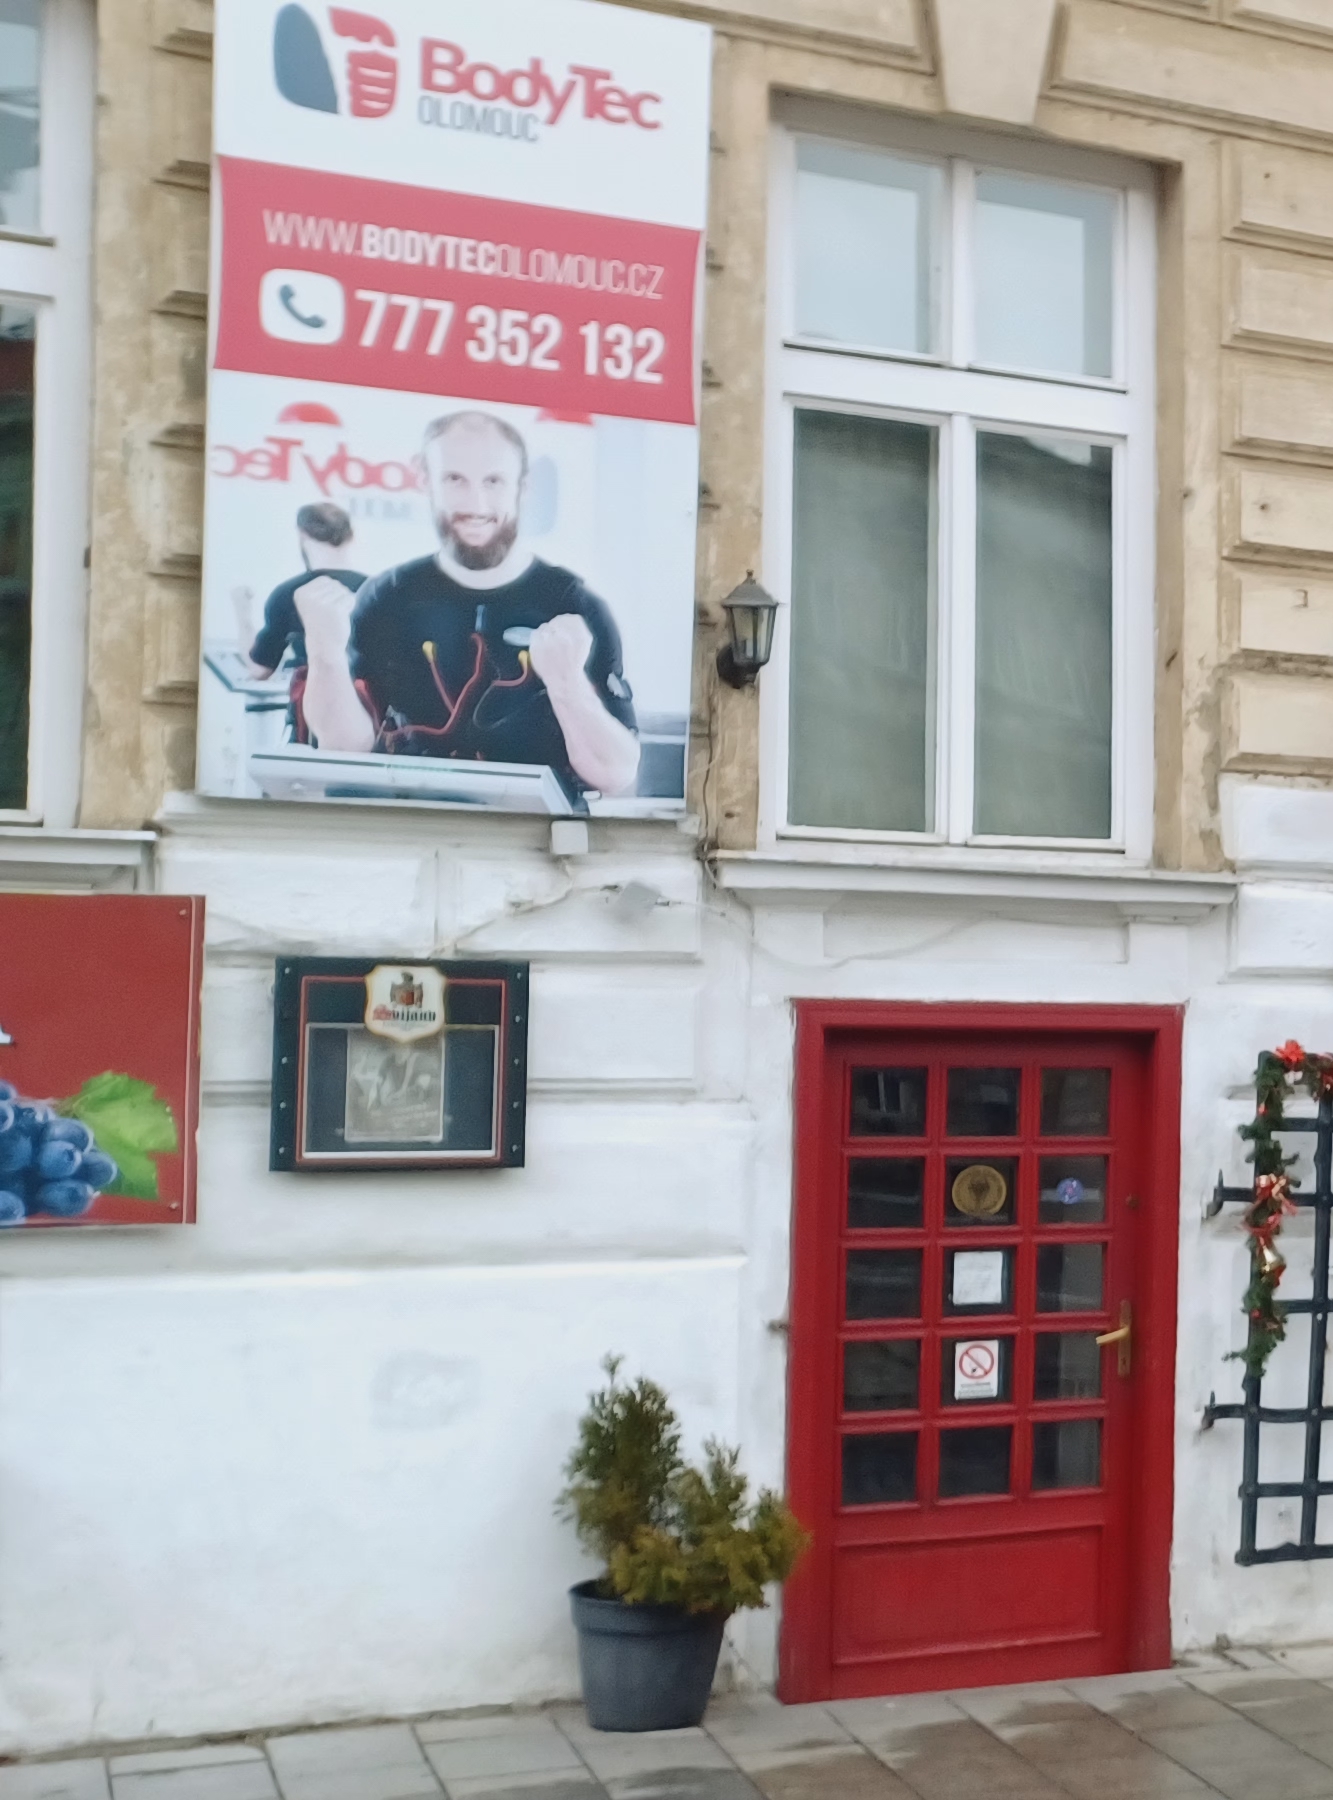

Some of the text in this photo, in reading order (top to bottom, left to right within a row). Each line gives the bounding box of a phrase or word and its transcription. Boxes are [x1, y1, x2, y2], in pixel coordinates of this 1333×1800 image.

[418, 96, 539, 142] OLOMOUC
[419, 37, 662, 129] BodyTec
[262, 210, 665, 299] WWW.BODYTECOLOMOUC.CZ
[355, 289, 665, 384] 777 352 132
